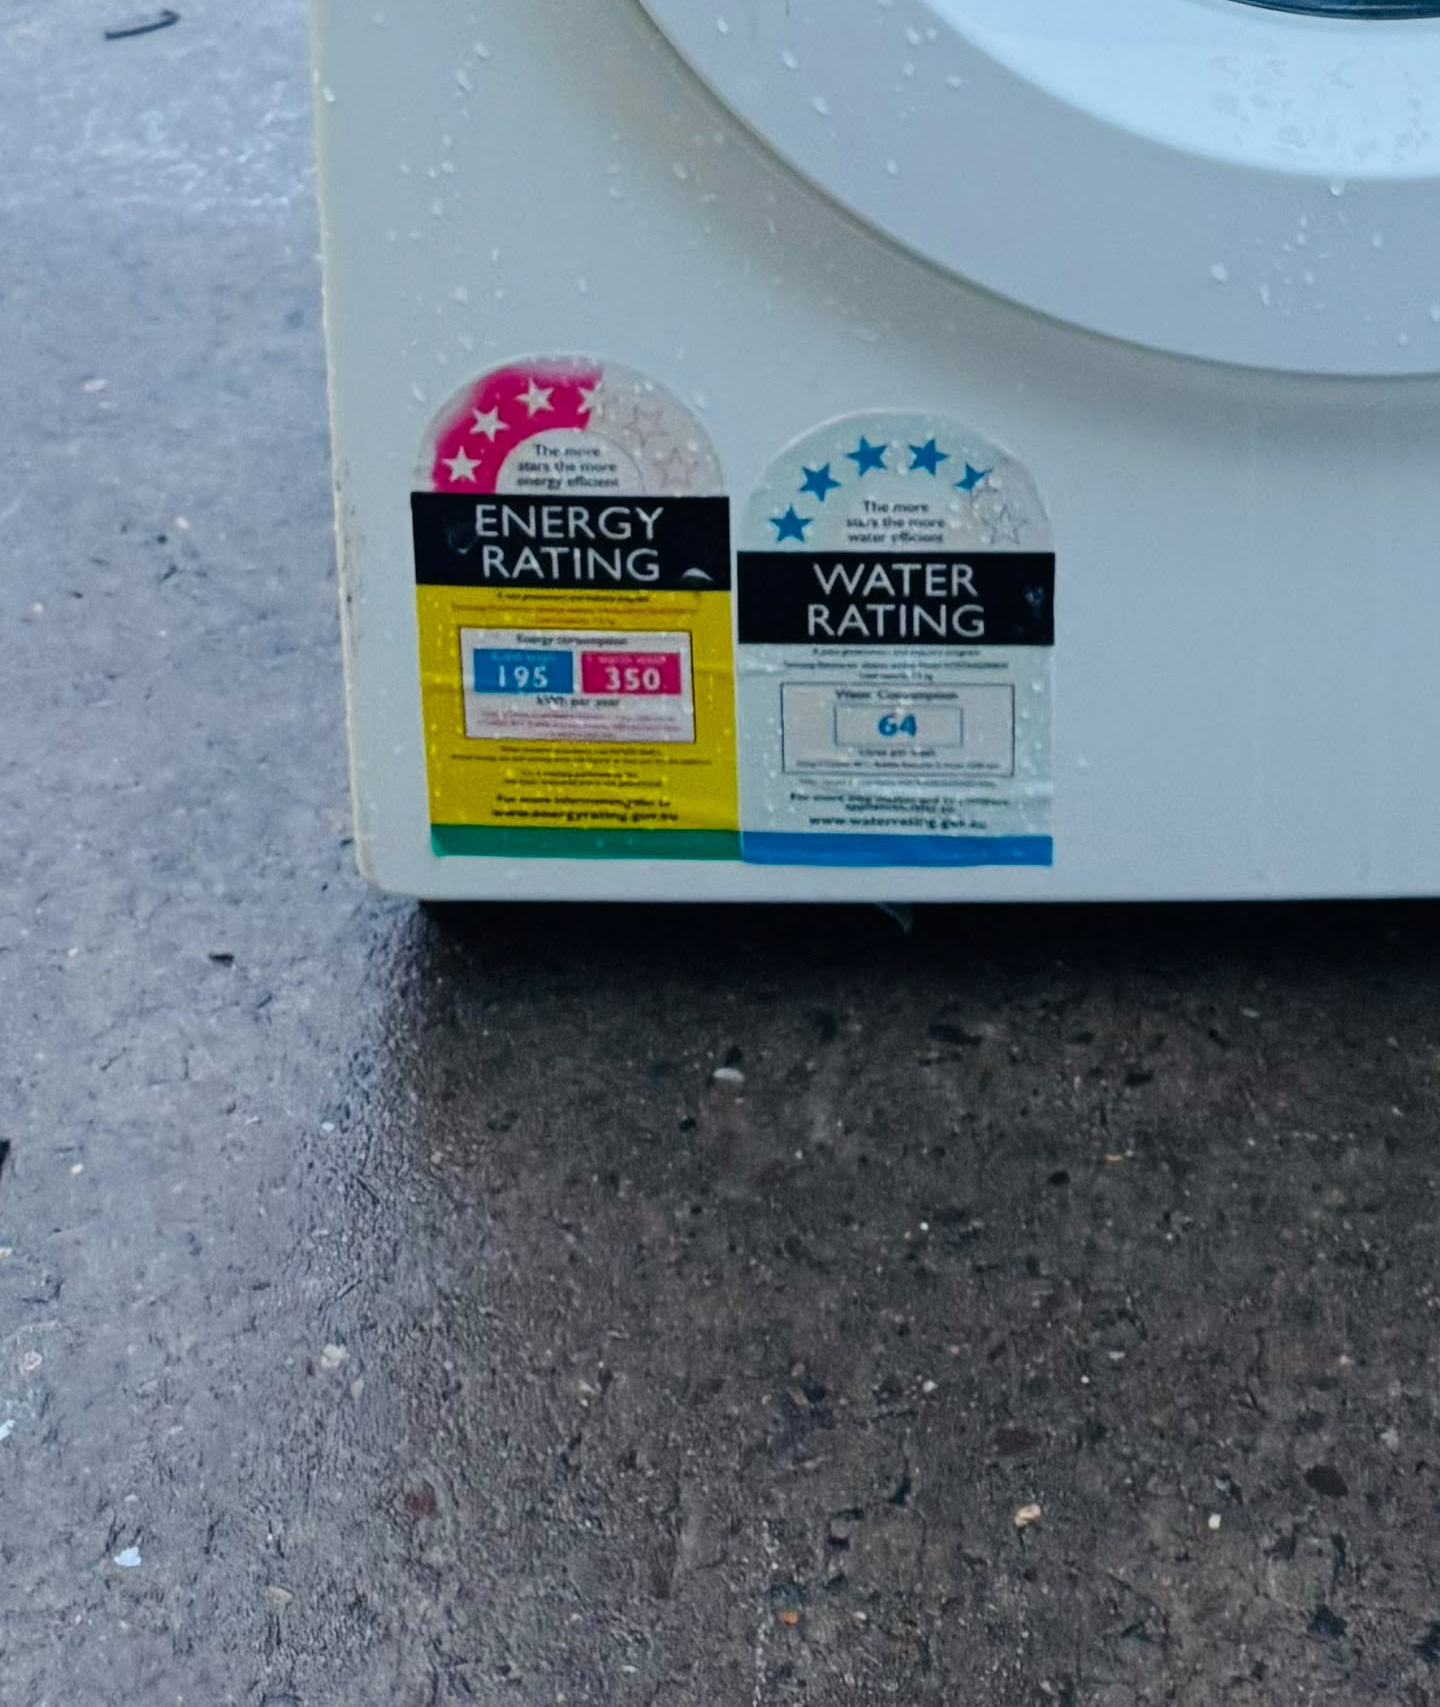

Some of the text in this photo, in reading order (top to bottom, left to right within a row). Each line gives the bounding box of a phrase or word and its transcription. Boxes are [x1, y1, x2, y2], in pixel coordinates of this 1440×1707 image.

[534, 444, 600, 457] The more
[554, 461, 576, 472] the
[580, 463, 617, 472] more
[863, 500, 929, 513] The more
[474, 504, 664, 540] ENERGY
[908, 518, 945, 528] more
[482, 544, 661, 582] RATING
[813, 562, 978, 597] WATER
[807, 603, 985, 638] RATING
[499, 665, 548, 688] 195
[605, 666, 661, 691] 350
[878, 713, 917, 736] 64
